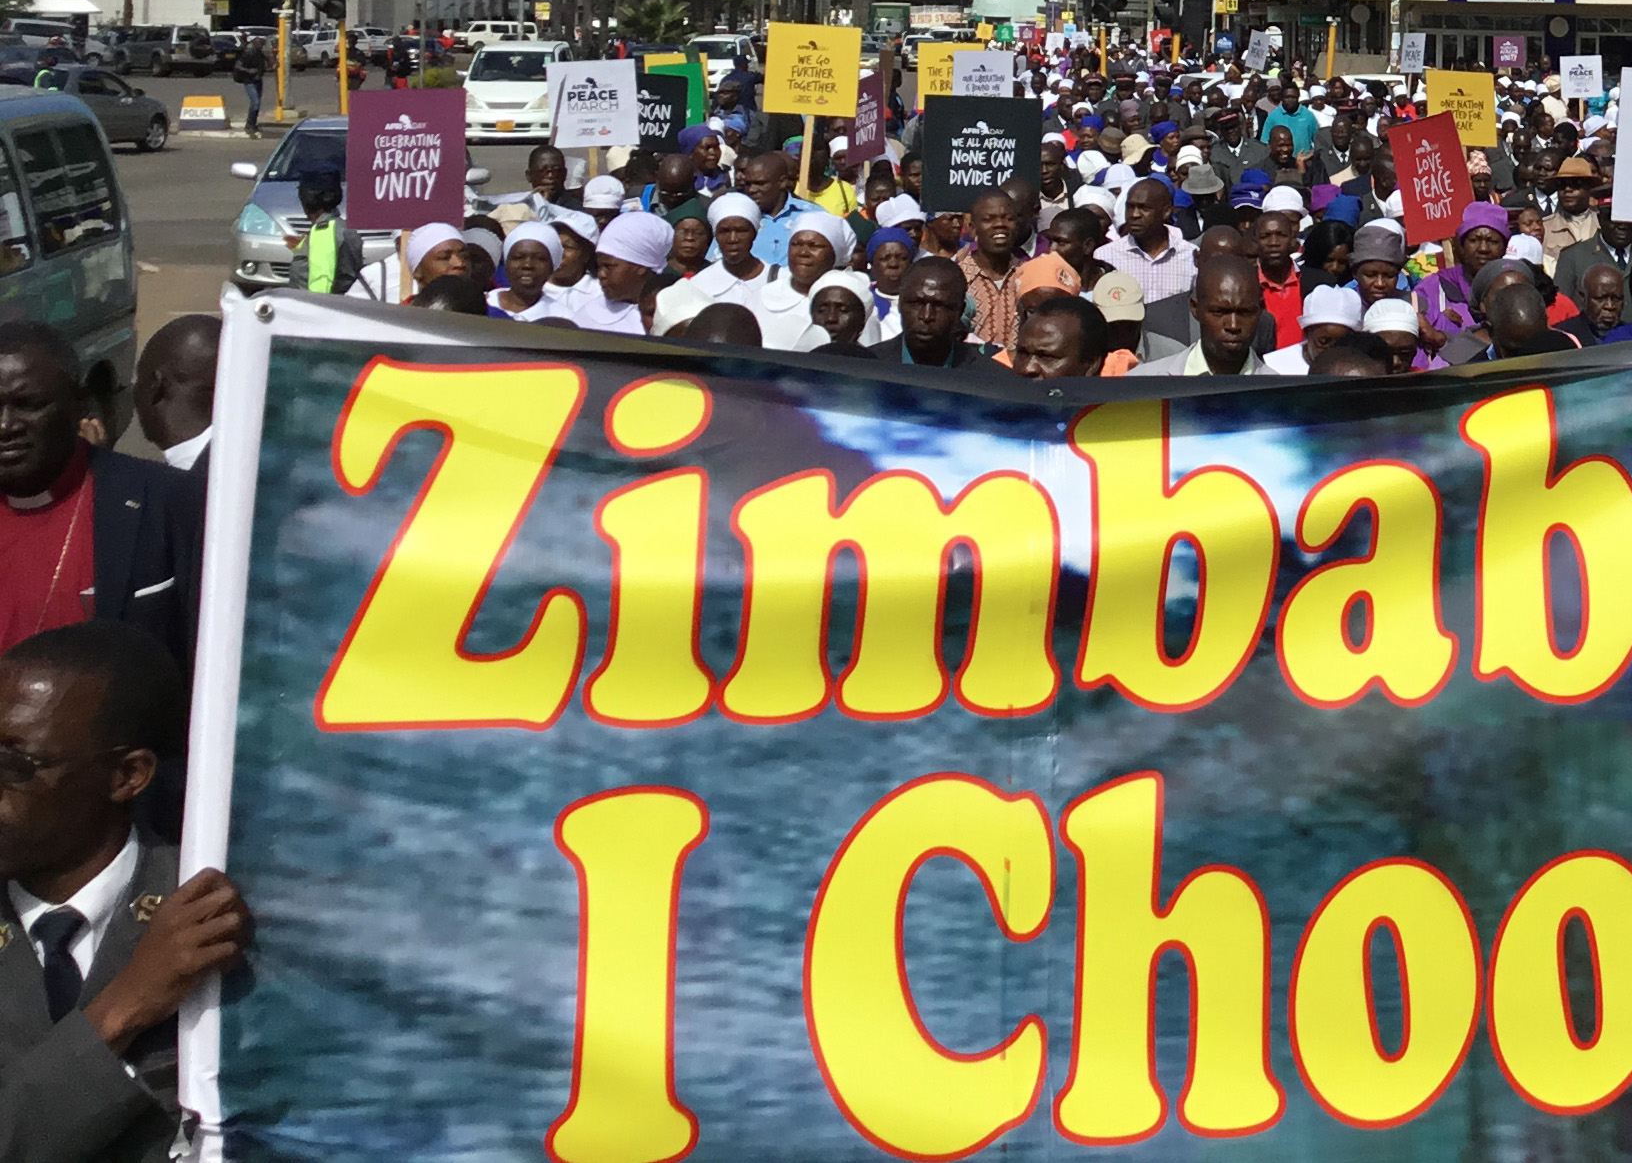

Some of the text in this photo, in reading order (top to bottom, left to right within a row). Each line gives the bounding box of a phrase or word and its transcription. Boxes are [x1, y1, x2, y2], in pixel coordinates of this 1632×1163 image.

[798, 55, 830, 67] WE GO
[791, 65, 835, 79] FURTHER
[927, 67, 943, 77] THE
[787, 78, 838, 94] TOGETHER
[567, 89, 618, 102] PEACE
[567, 100, 619, 112] MARCH
[637, 102, 672, 121] RICAN
[1440, 99, 1484, 110] ONE NATION
[183, 108, 214, 118] POLICE
[1468, 111, 1483, 121] FOR
[638, 122, 671, 139] UDLY
[1456, 121, 1473, 131] EACE
[374, 133, 442, 150] CELEBRATING
[951, 137, 1017, 150] WE ALL AFRICAN
[372, 148, 441, 172] AFRICAN
[951, 149, 1015, 168] NONE CAN
[1415, 152, 1443, 175] LOVE
[949, 168, 993, 186] DIVIDE
[374, 170, 437, 202] UNITY
[1412, 170, 1454, 202] PEACE
[1421, 197, 1453, 220] TRUST
[543, 783, 711, 1163] I
